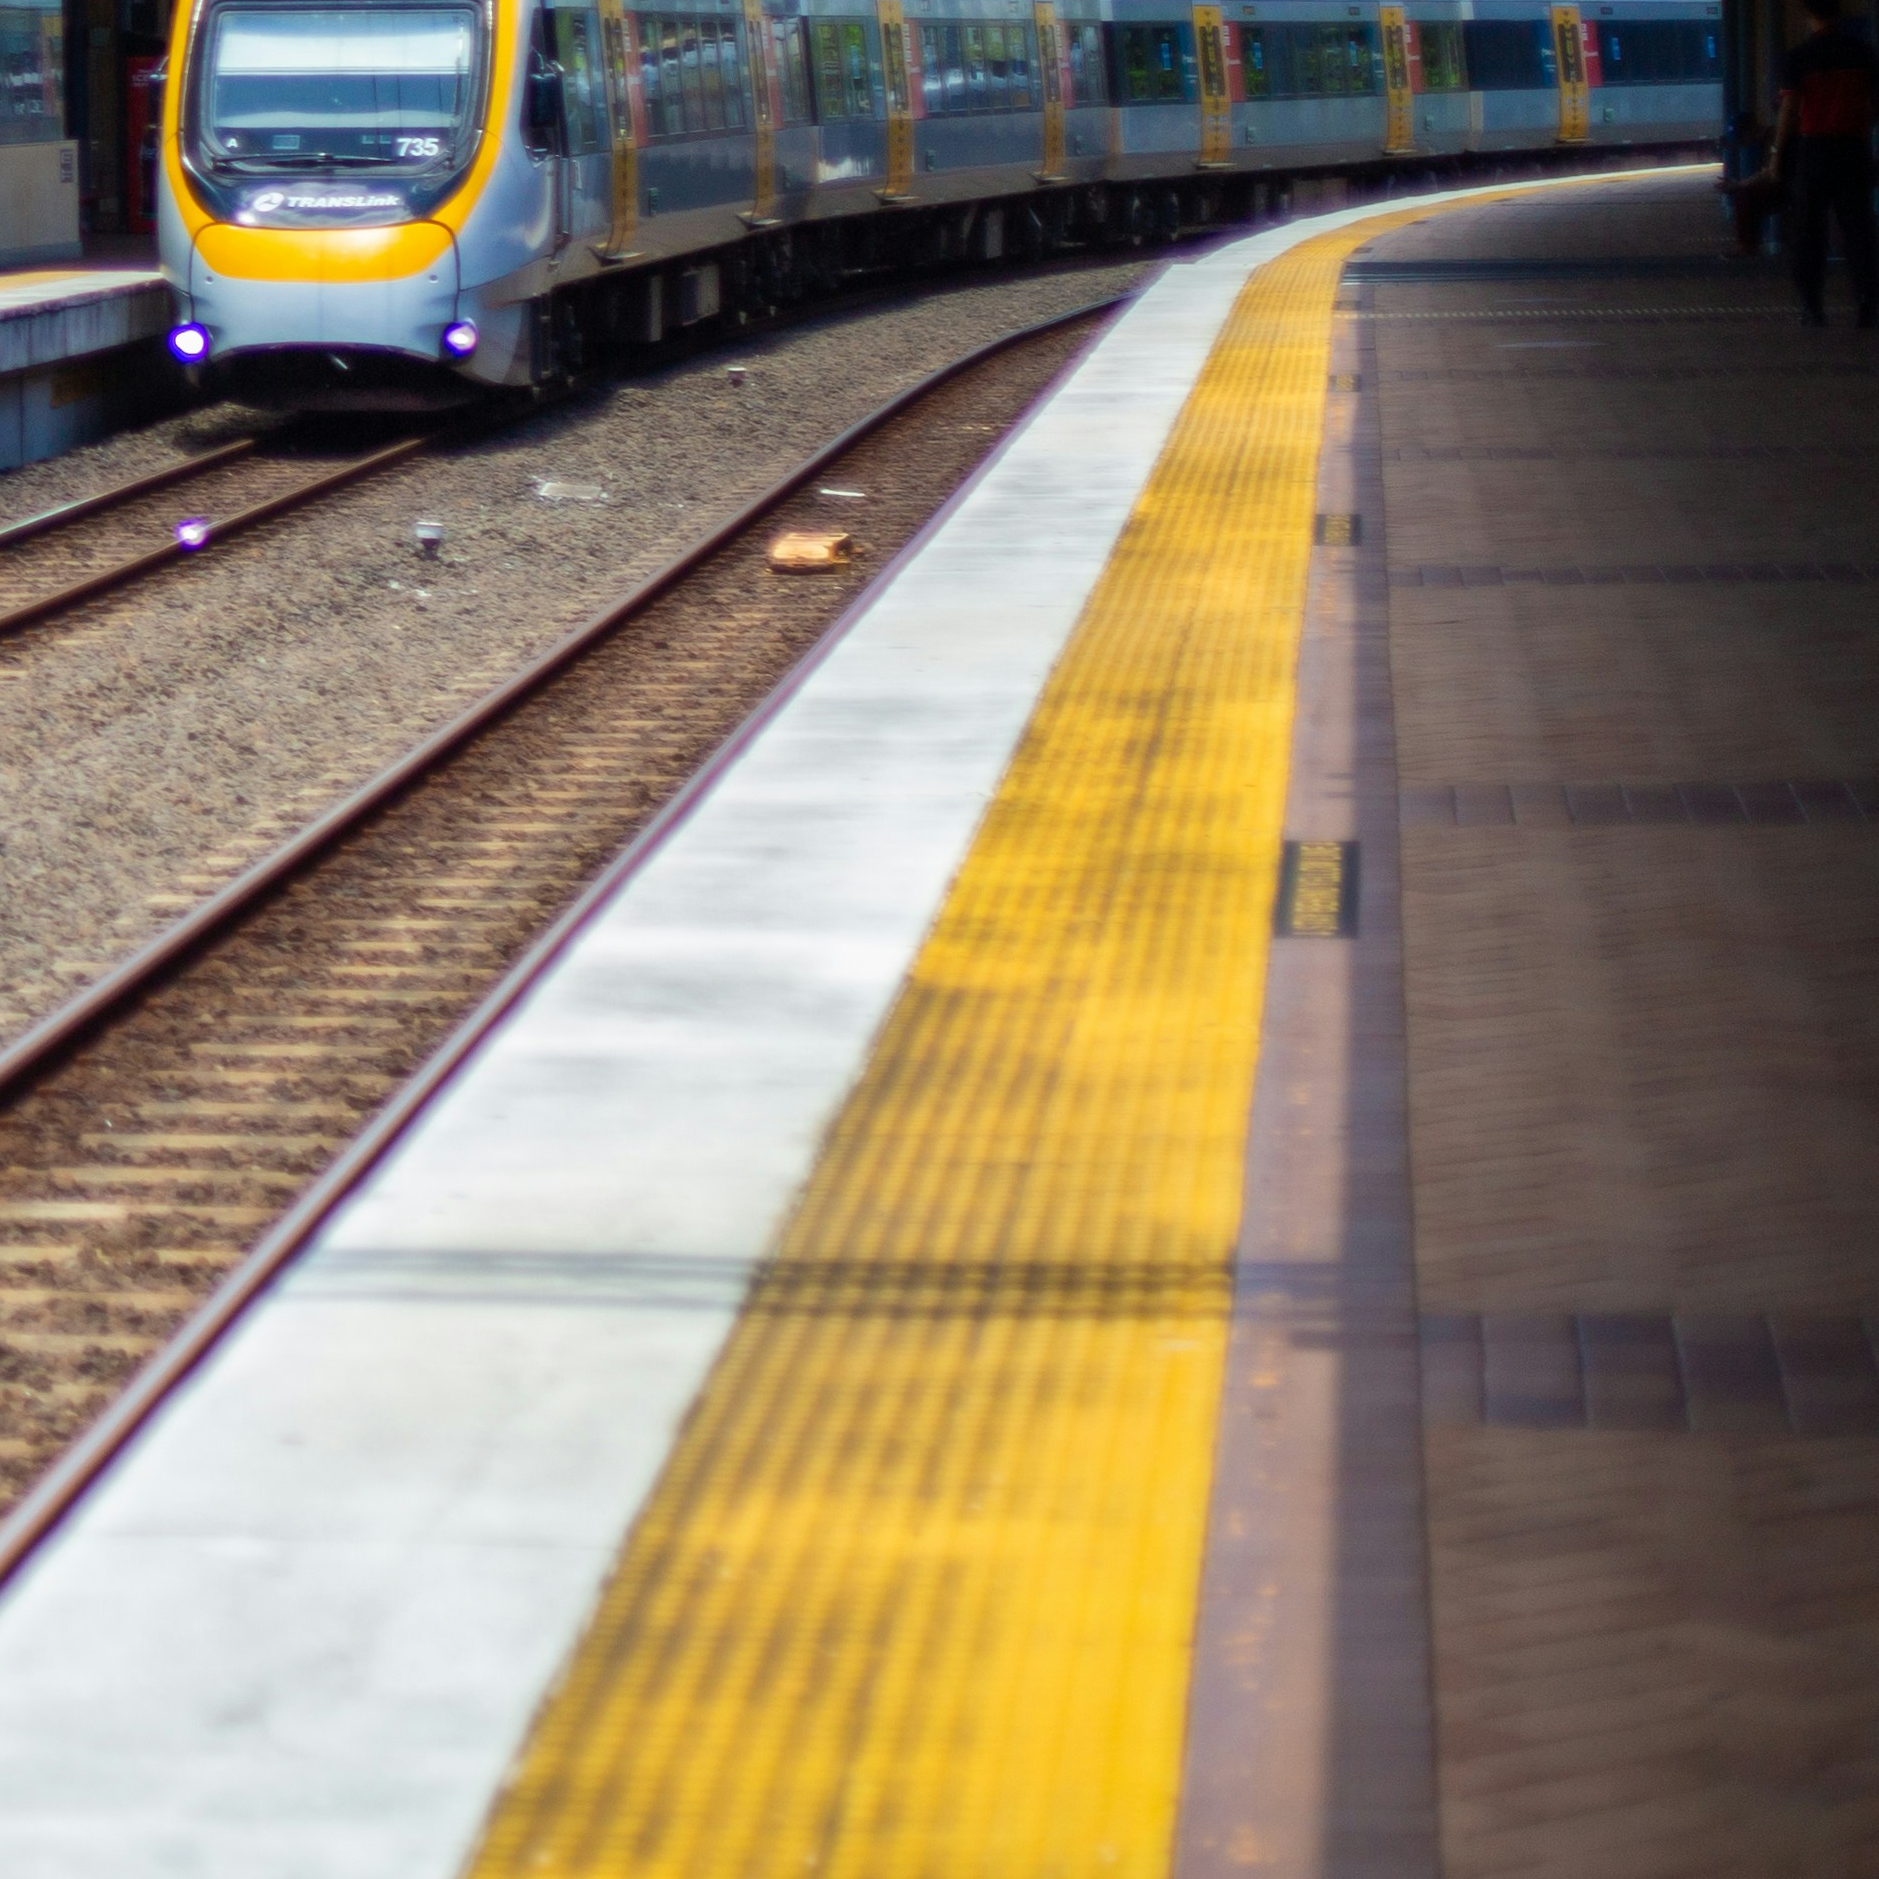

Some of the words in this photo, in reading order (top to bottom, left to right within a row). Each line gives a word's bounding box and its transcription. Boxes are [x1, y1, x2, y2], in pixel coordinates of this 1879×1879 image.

[226, 137, 238, 148] A
[396, 137, 439, 156] 735
[287, 194, 400, 207] TRANSLink
